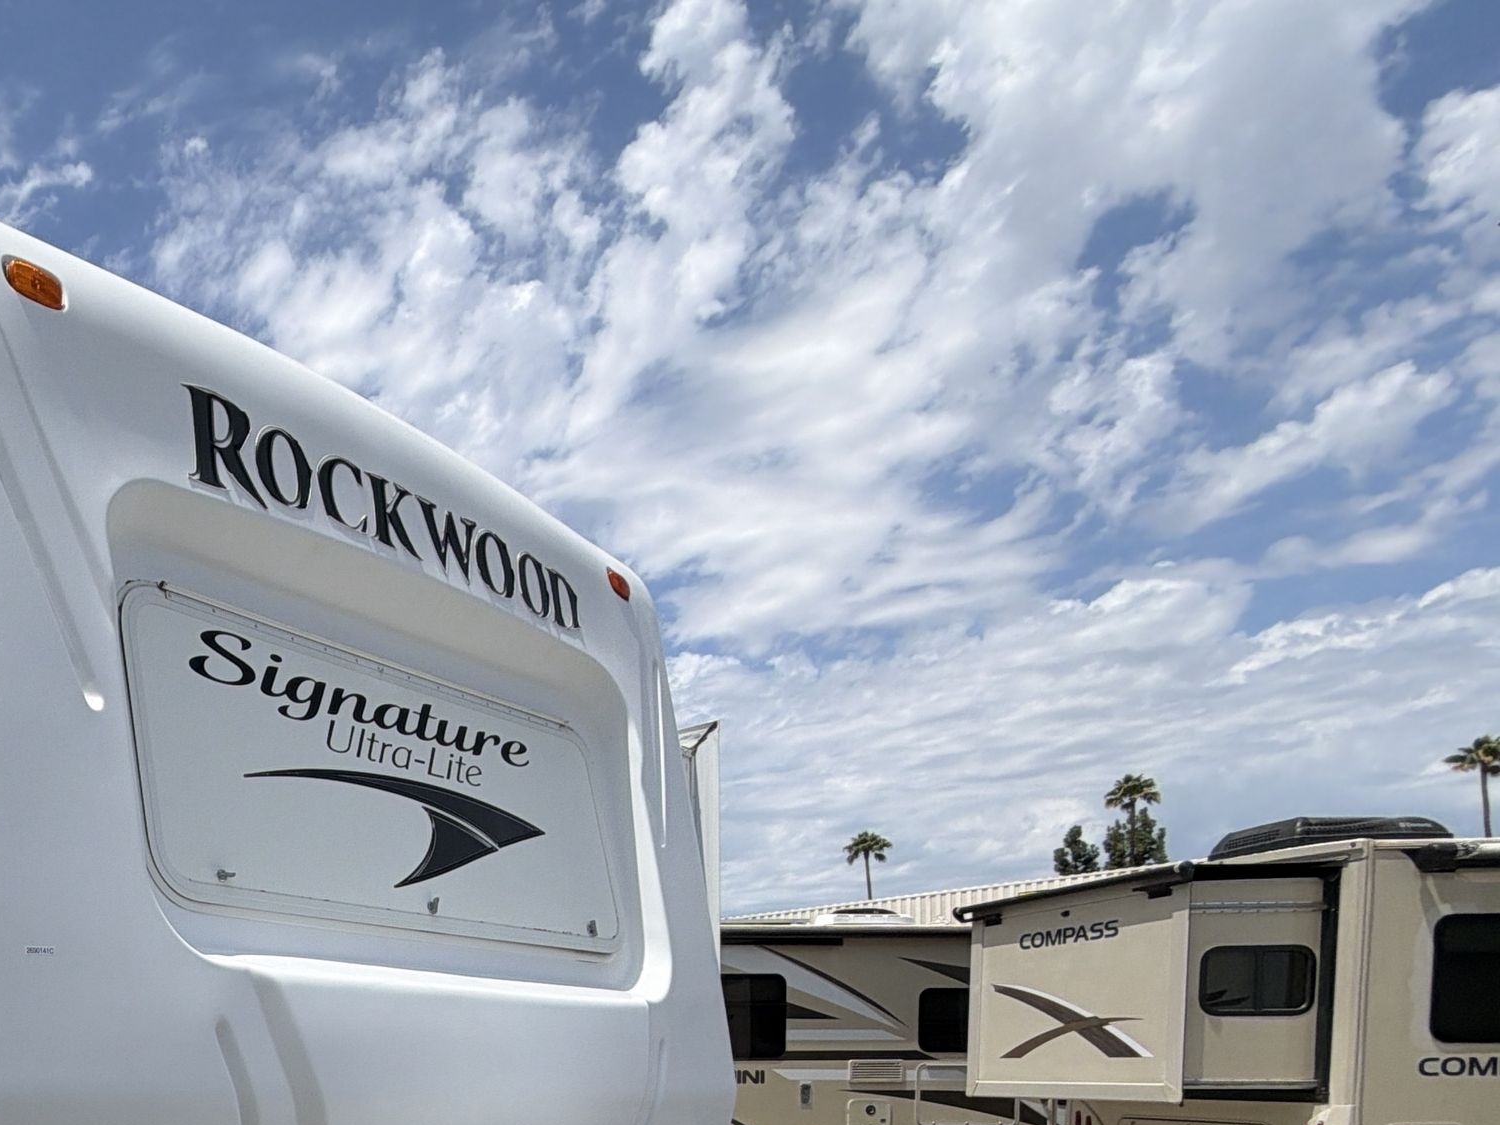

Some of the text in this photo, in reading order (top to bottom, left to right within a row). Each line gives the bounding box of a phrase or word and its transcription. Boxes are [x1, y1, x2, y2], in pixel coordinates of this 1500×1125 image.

[181, 383, 580, 629] ROCKWOOD
[188, 630, 530, 767] Signature
[326, 719, 483, 787] Ultra-Lite
[1019, 920, 1119, 950] COMPASS
[734, 1069, 765, 1084] INI
